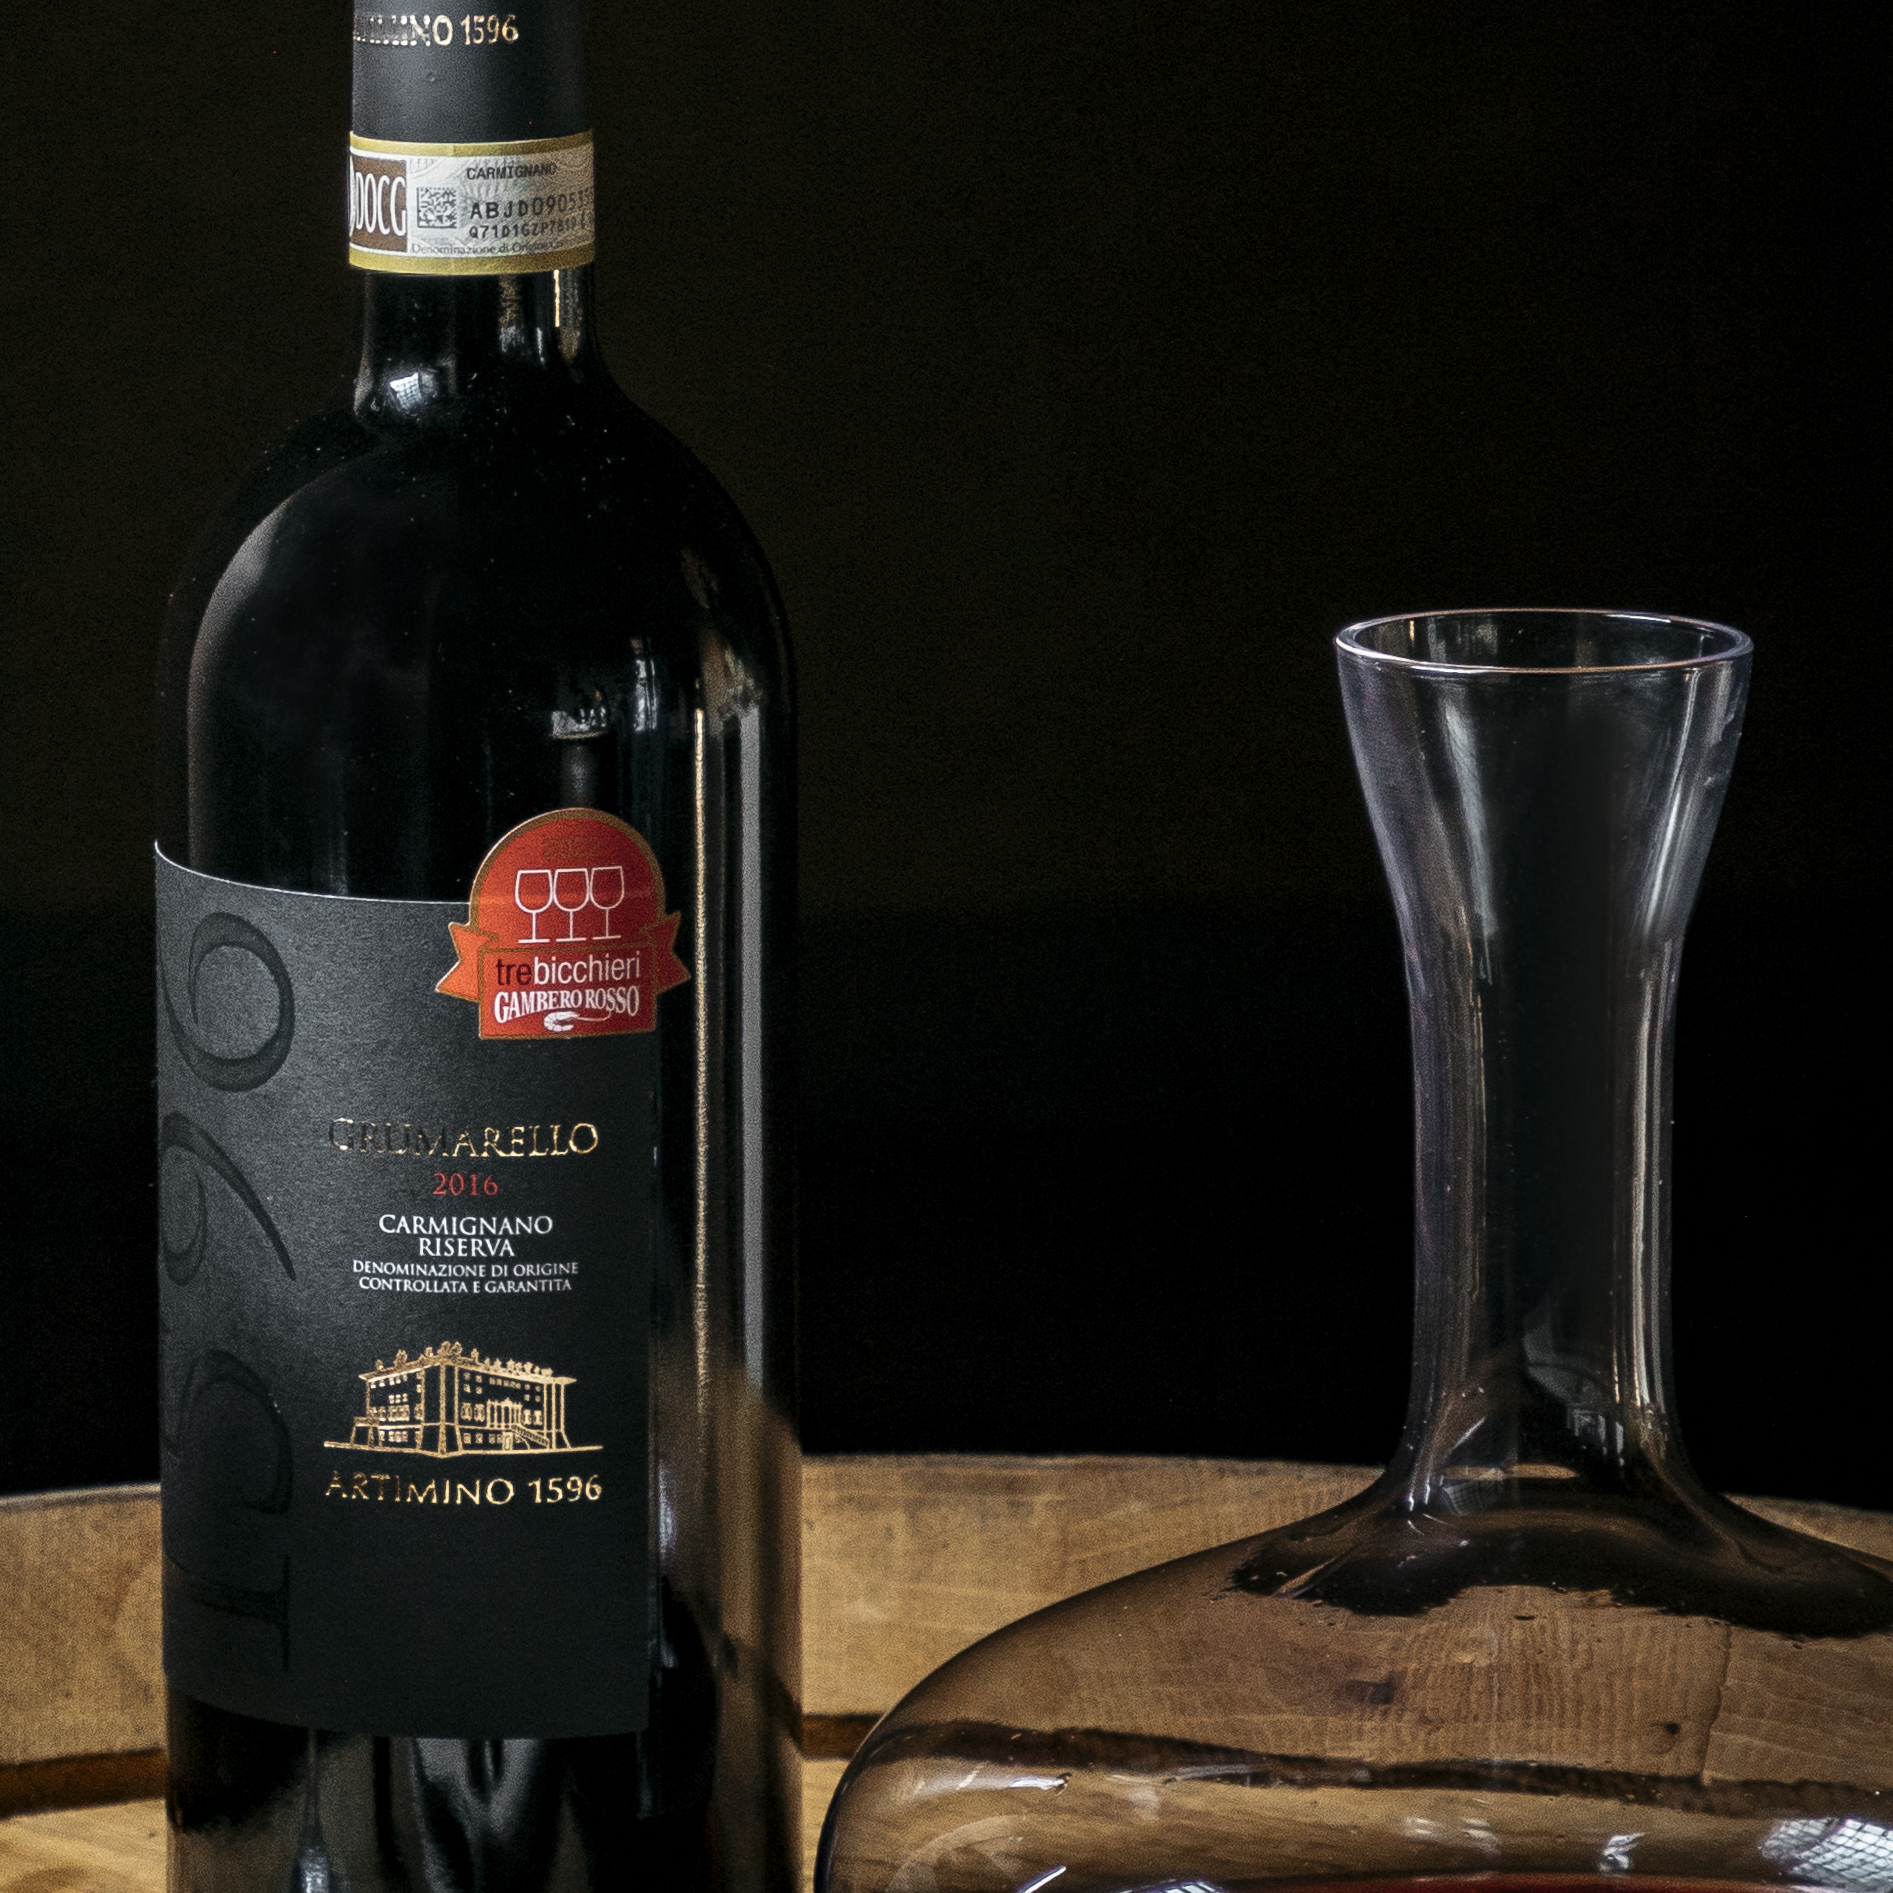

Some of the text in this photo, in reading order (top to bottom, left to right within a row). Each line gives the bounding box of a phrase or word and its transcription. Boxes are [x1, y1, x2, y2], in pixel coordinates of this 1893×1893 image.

[461, 13, 519, 45] 1596
[466, 162, 556, 180] CARMIGNANO
[496, 950, 641, 986] trebicchieri
[494, 985, 640, 1024] GAMBERO ROSSO
[328, 1117, 599, 1157] GRUMARELLO
[432, 1172, 499, 1196] 2016
[379, 1214, 553, 1235] CARMIGNANO
[419, 1237, 515, 1257] RISERVA
[352, 1259, 579, 1277] DENOMINAZIONE DI ORIGINE
[359, 1276, 572, 1293] CONTROLLATA E GARANTITA
[324, 1470, 603, 1506] ARTIMINO 1596
